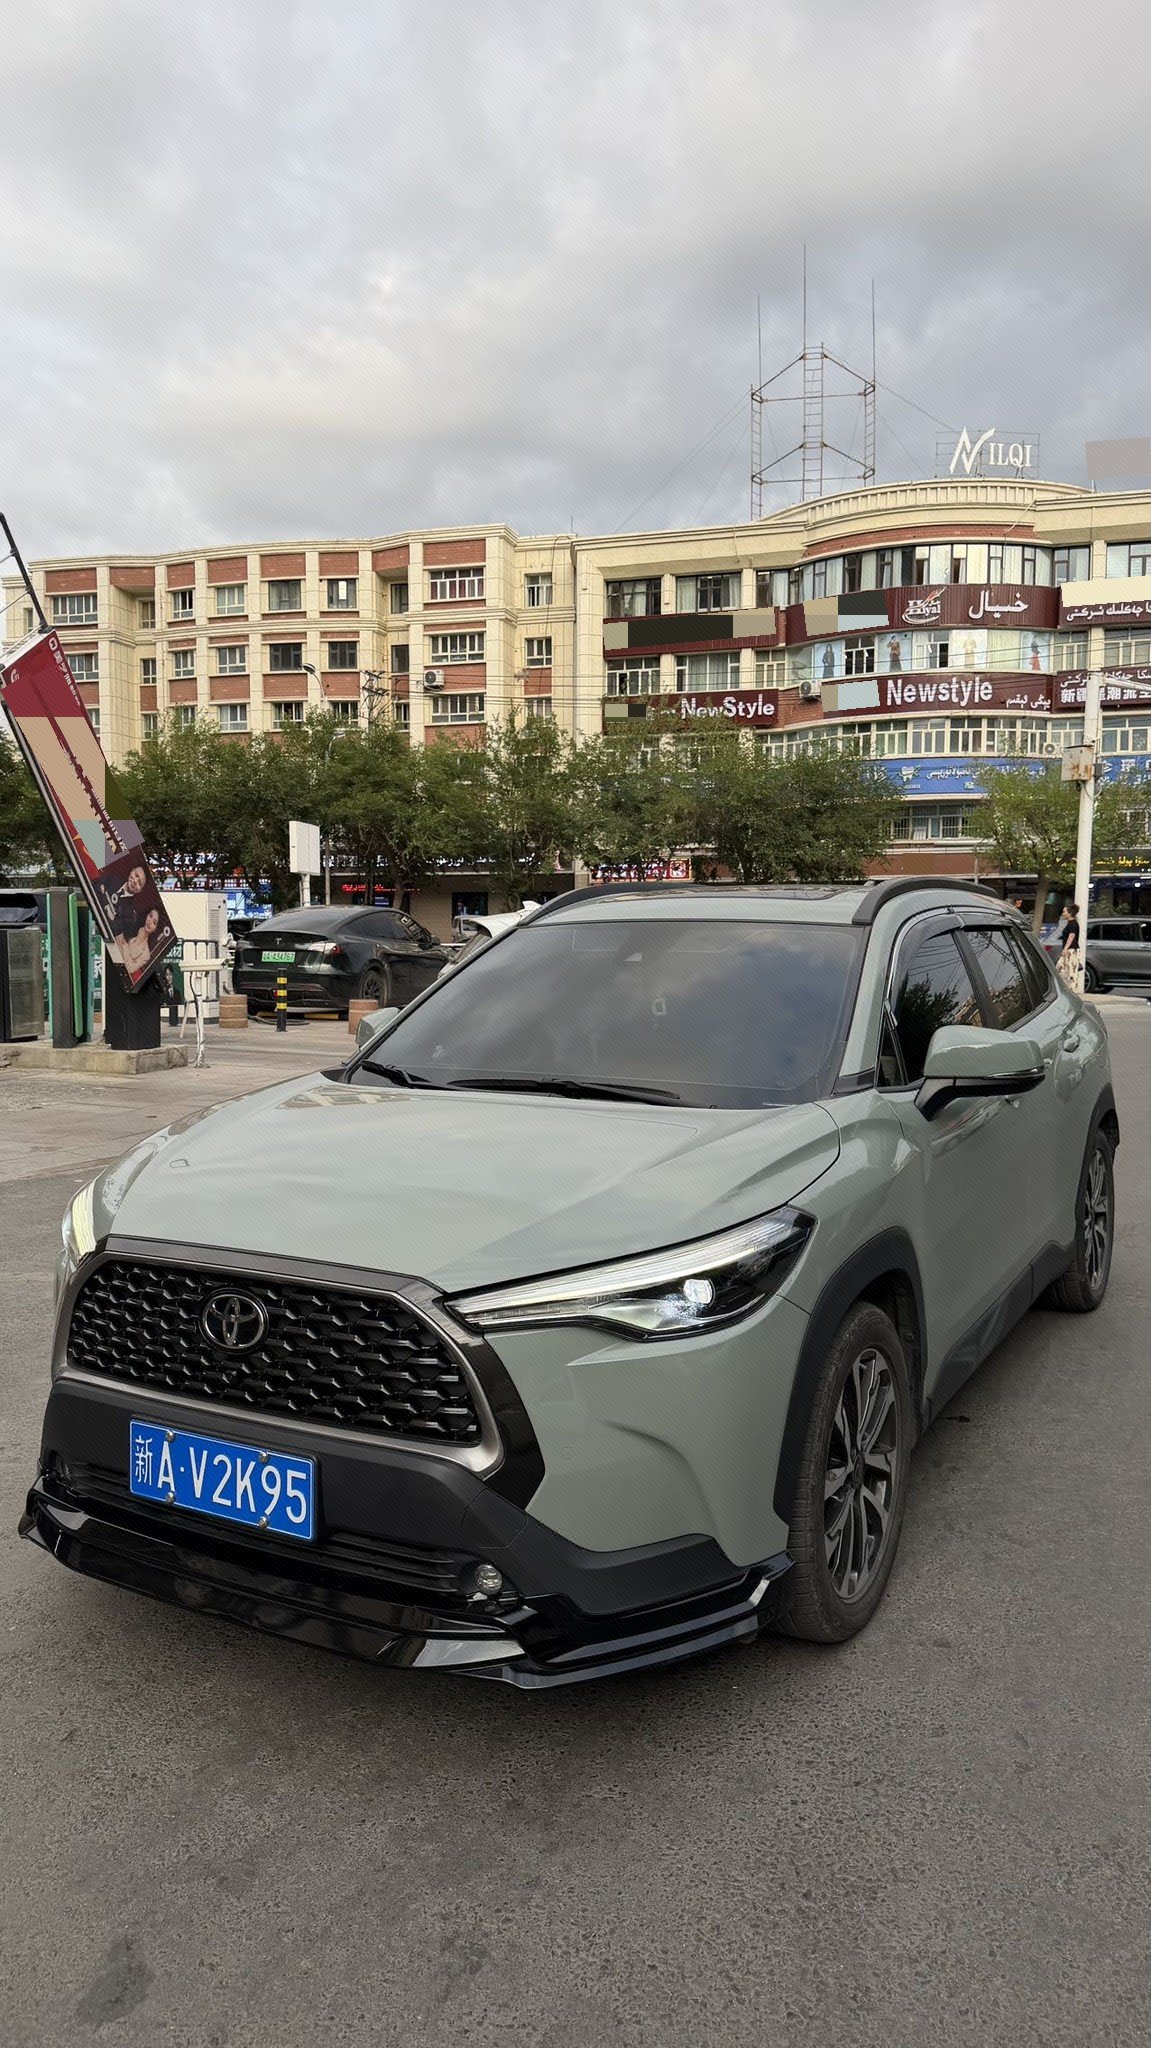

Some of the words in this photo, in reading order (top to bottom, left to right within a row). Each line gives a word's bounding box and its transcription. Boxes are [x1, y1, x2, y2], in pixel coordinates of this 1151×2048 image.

[949, 426, 1032, 475] NILQI
[887, 676, 993, 707] Newstyle
[134, 1435, 307, 1524] 新A·V2K95
